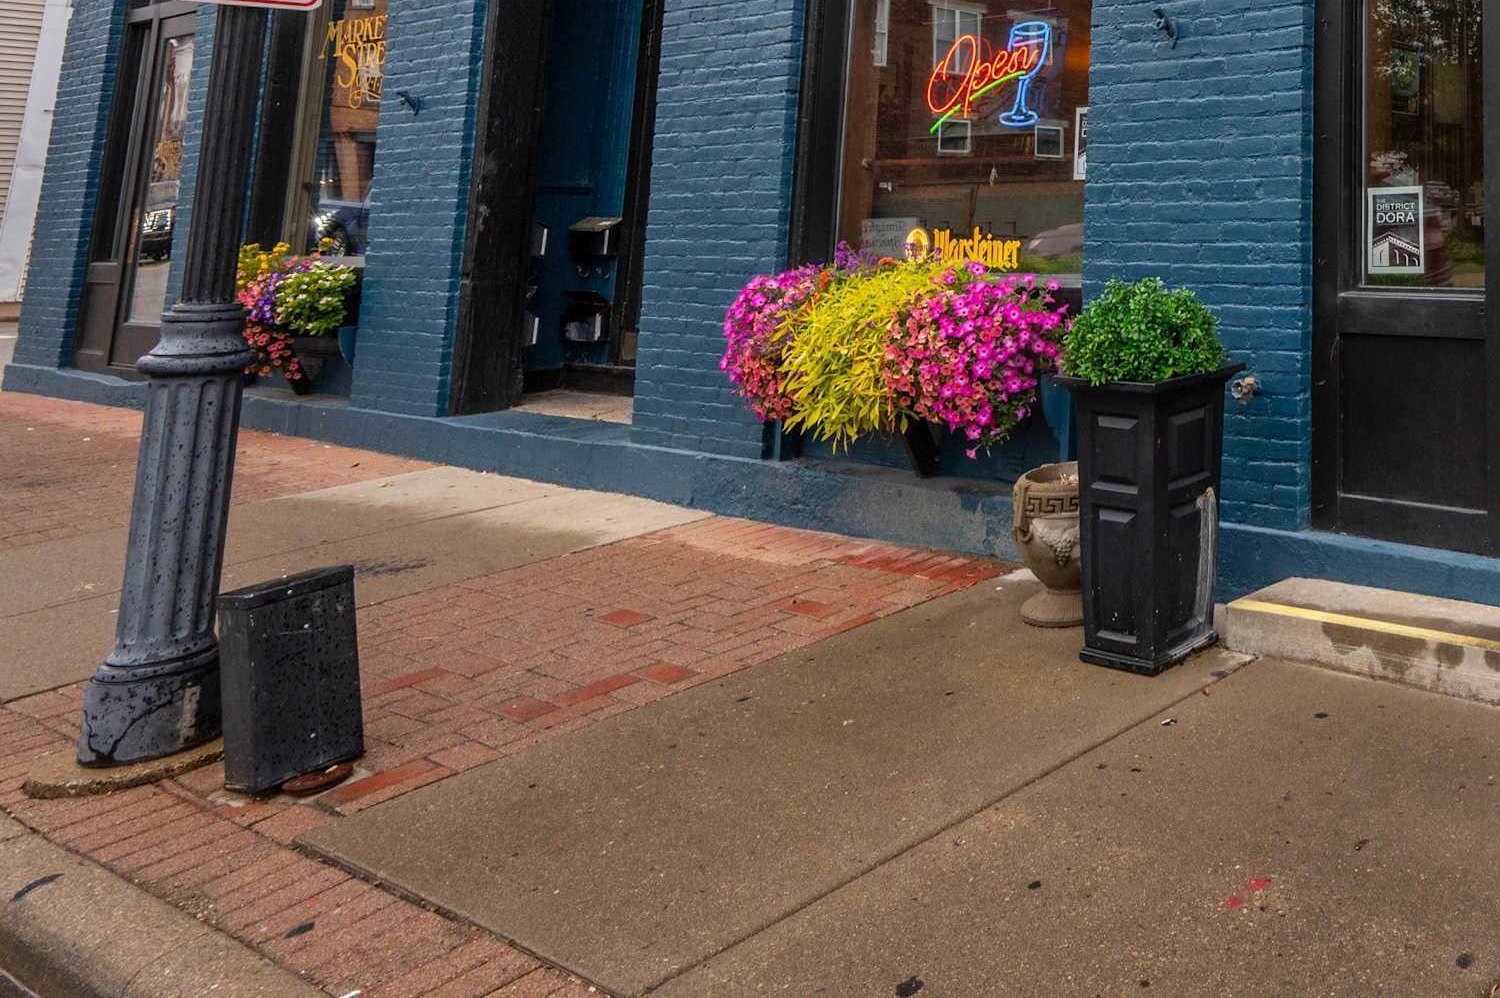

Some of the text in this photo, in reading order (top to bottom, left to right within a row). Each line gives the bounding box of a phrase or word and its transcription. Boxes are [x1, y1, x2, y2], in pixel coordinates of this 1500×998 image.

[317, 15, 388, 59] MARKE
[927, 34, 1039, 119] Open
[1376, 202, 1415, 211] DISTRICT
[1376, 212, 1415, 223] DORA
